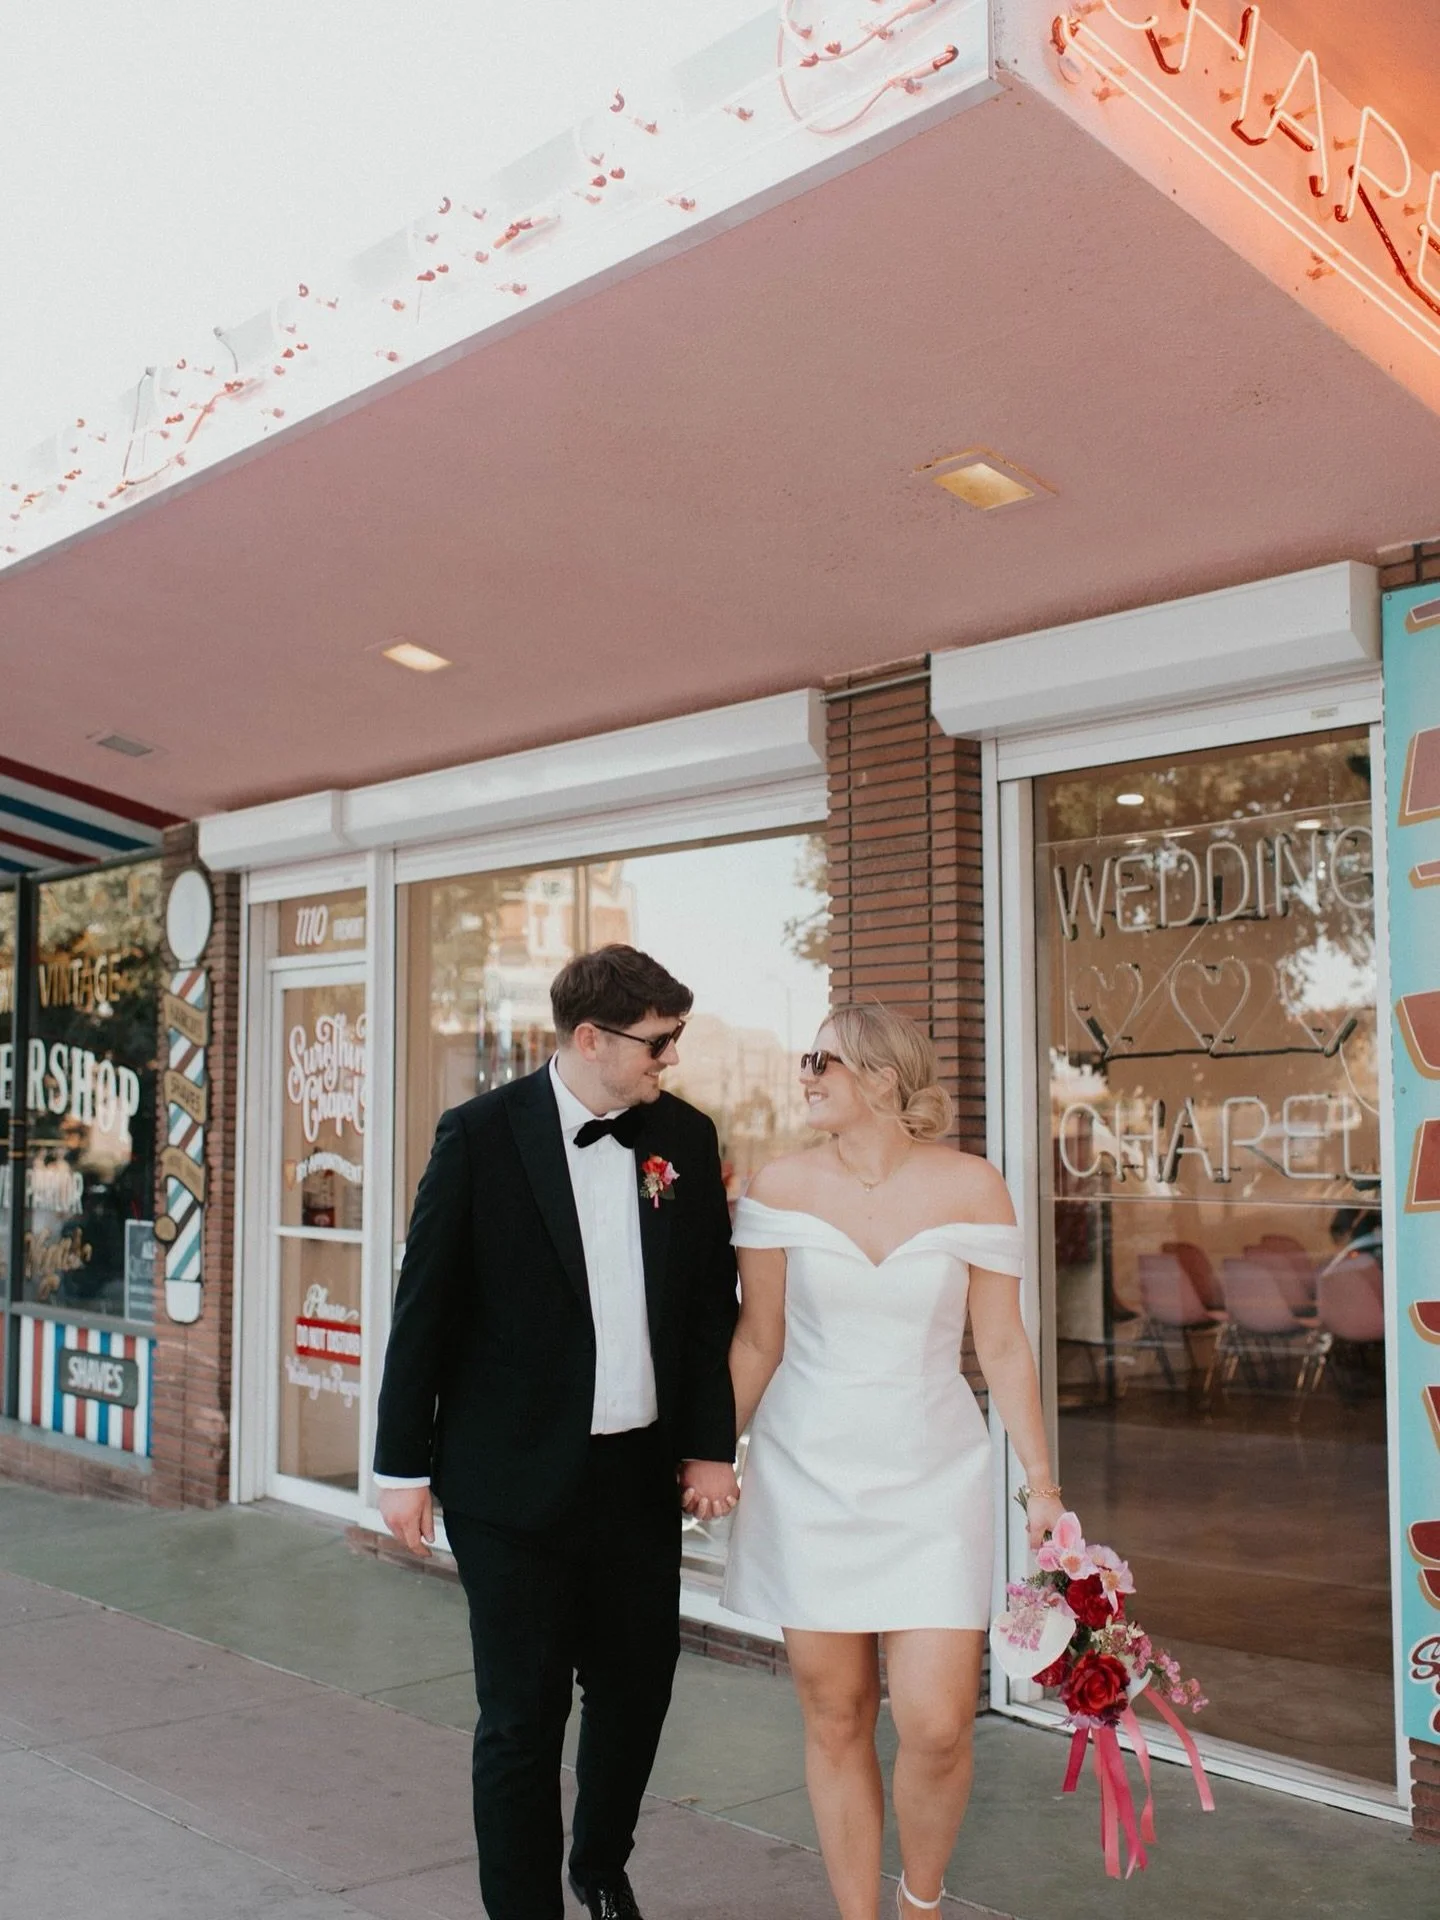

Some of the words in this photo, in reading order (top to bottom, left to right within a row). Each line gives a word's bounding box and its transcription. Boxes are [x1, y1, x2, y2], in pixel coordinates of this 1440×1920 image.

[1053, 825, 1374, 941] WEDDING
[295, 904, 328, 946] 1110
[38, 953, 121, 1013] VINTAGE
[1058, 1094, 1381, 1181] CHAPEL
[68, 1355, 124, 1397] SHAVES
